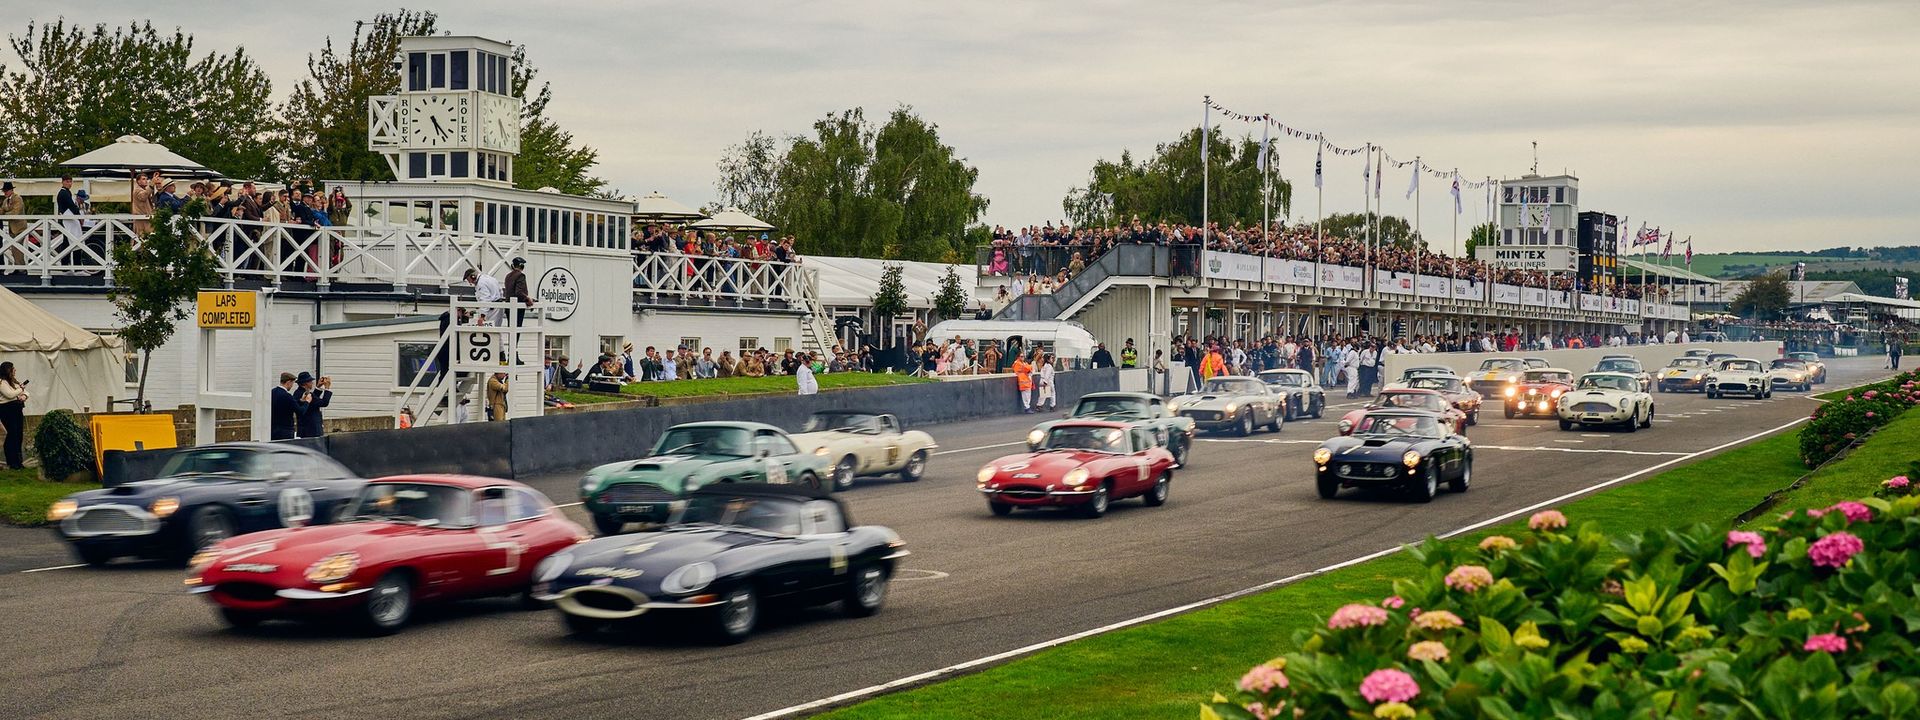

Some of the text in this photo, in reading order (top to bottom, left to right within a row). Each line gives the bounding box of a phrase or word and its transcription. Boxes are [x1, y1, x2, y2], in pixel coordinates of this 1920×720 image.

[1496, 251, 1545, 259] MINTEX
[216, 295, 236, 306] LAPS
[541, 287, 576, 306] Ralph Lauren
[1263, 292, 1269, 300] 2
[1290, 294, 1296, 302] 3
[202, 312, 250, 324] COMPLETED
